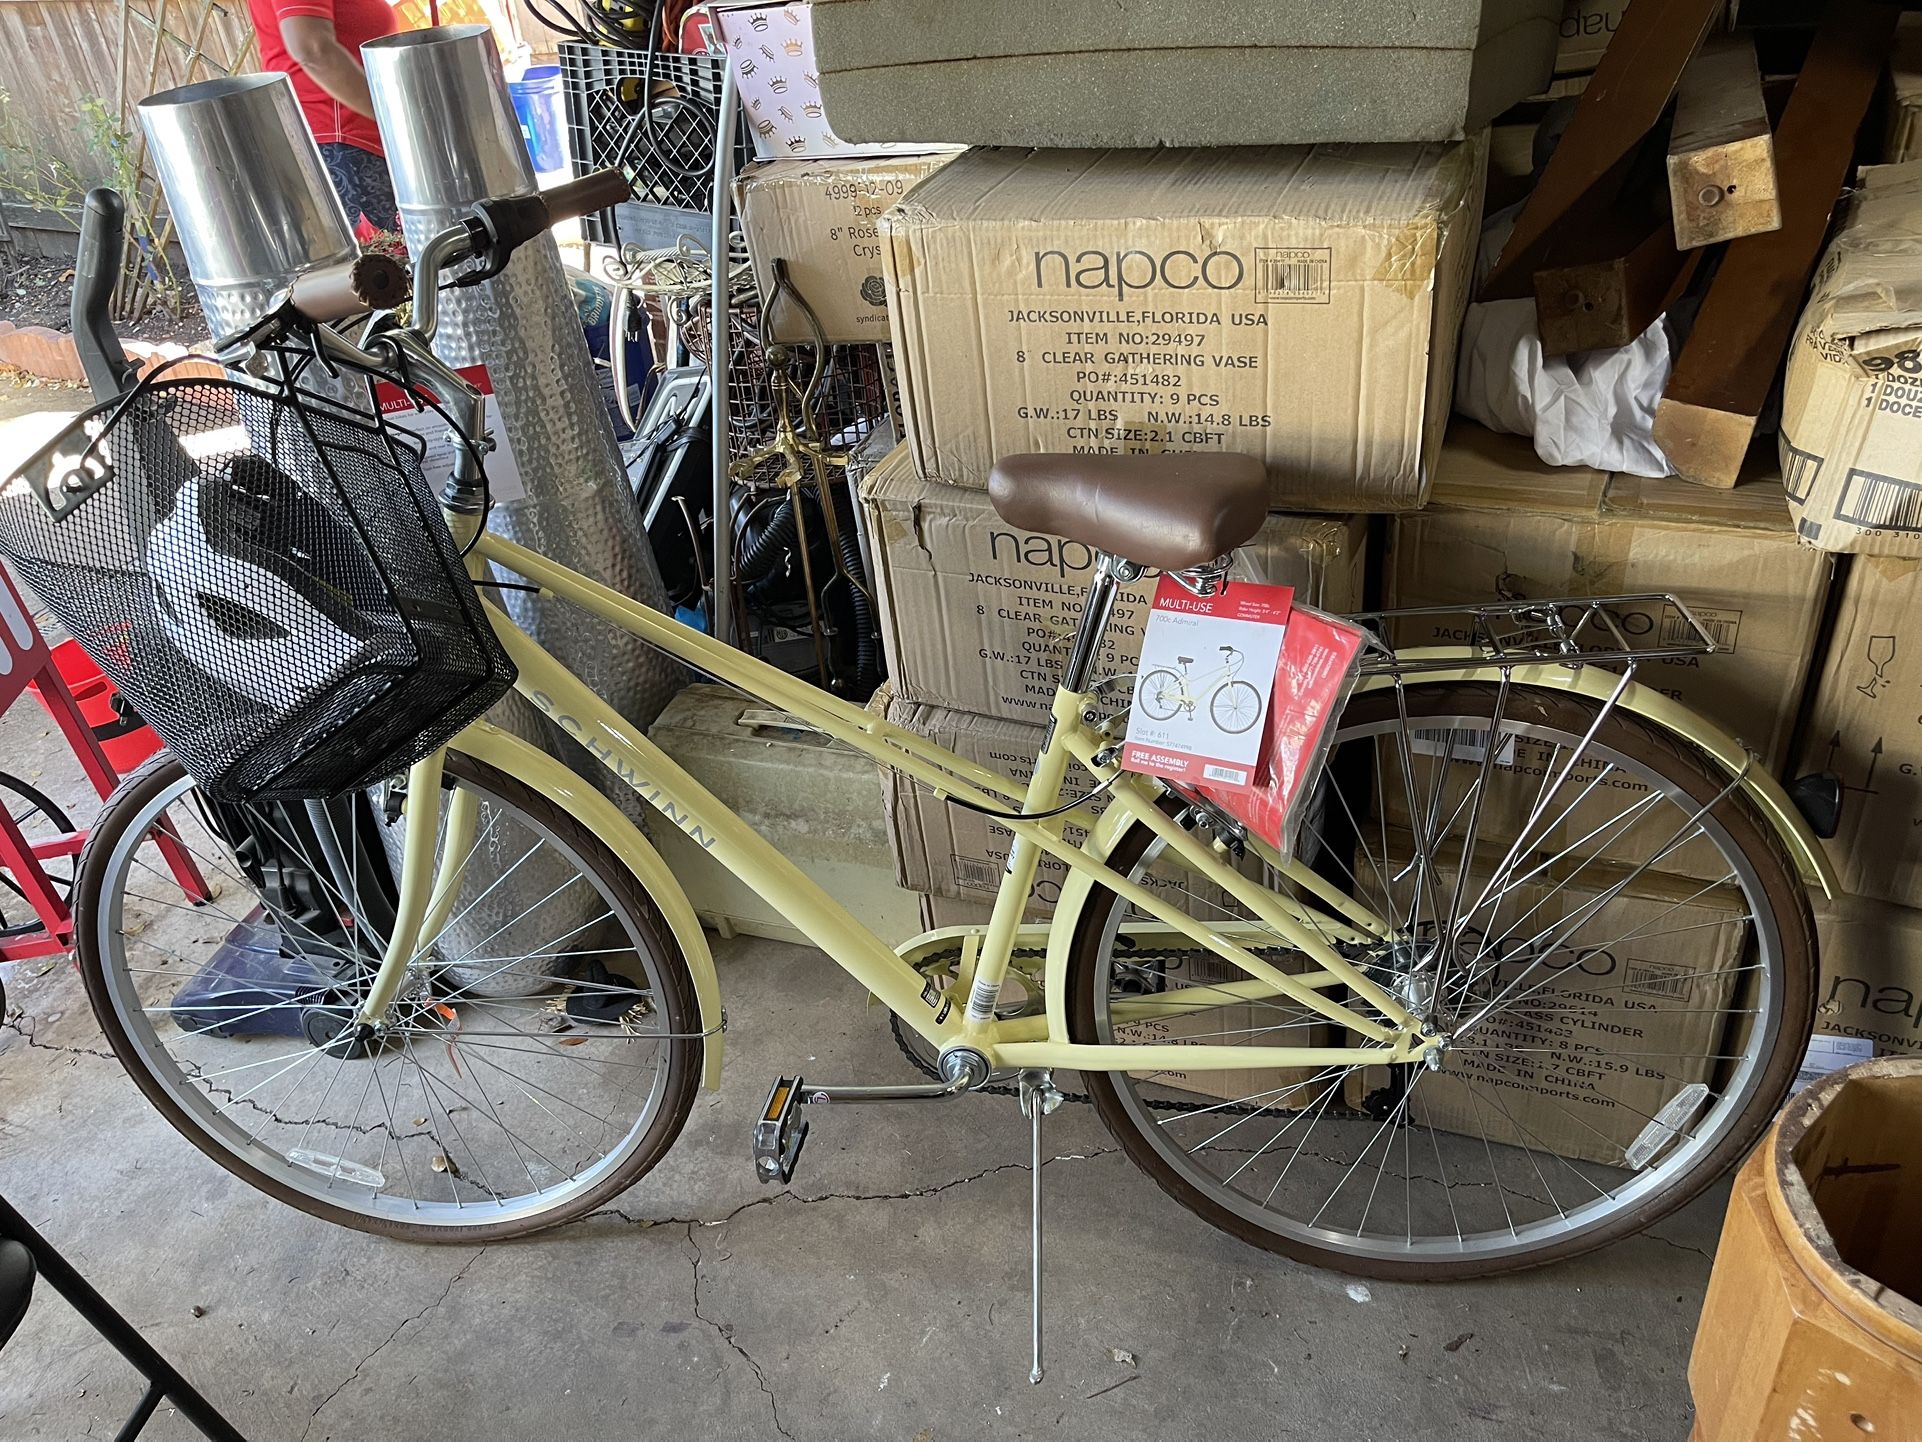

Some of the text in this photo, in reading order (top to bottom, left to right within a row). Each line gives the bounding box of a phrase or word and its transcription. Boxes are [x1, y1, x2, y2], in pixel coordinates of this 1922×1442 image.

[825, 180, 904, 200] 4999-12-09
[864, 206, 882, 218] pcs
[1275, 250, 1311, 262] napco
[1034, 249, 1244, 302] napco
[1231, 312, 1268, 327] USA
[1065, 331, 1206, 348] ITEM NO:29497
[1041, 351, 1095, 365] CLEAR
[1104, 351, 1205, 368] GATHERING
[1212, 354, 1258, 369] VASE
[1076, 370, 1182, 388] PO#:451482
[1069, 389, 1220, 407] QUANTITY: 9 PCS
[1017, 406, 1272, 428] G.W.:17 LBS N.W.:14.8 LBS
[1066, 427, 1225, 446] CTN SIZE:2.1 CBFT
[990, 531, 1097, 578] nap
[1017, 595, 1053, 610] ITEM
[1159, 597, 1213, 613] MULTI-USE
[998, 608, 1042, 624] CLEAR
[1172, 616, 1199, 627] Admiral
[978, 648, 1031, 665] G.W.:17
[1037, 657, 1063, 670] LBS
[1106, 652, 1115, 663] 9
[1020, 669, 1047, 682] CTN
[1157, 732, 1169, 740] 611
[1131, 750, 1189, 767] FREE ASSEMBLY
[531, 690, 716, 849] SCHWINN
[989, 825, 1015, 837] ASE
[1145, 1022, 1170, 1033] PCS
[1560, 1015, 1643, 1039] CYLINDER
[1559, 1040, 1568, 1050] 8
[1515, 1068, 1534, 1080] IN
[1550, 1051, 1629, 1074] N.W.:15.9
[1635, 1066, 1666, 1081] LBS
[1565, 1066, 1606, 1081] CBFT
